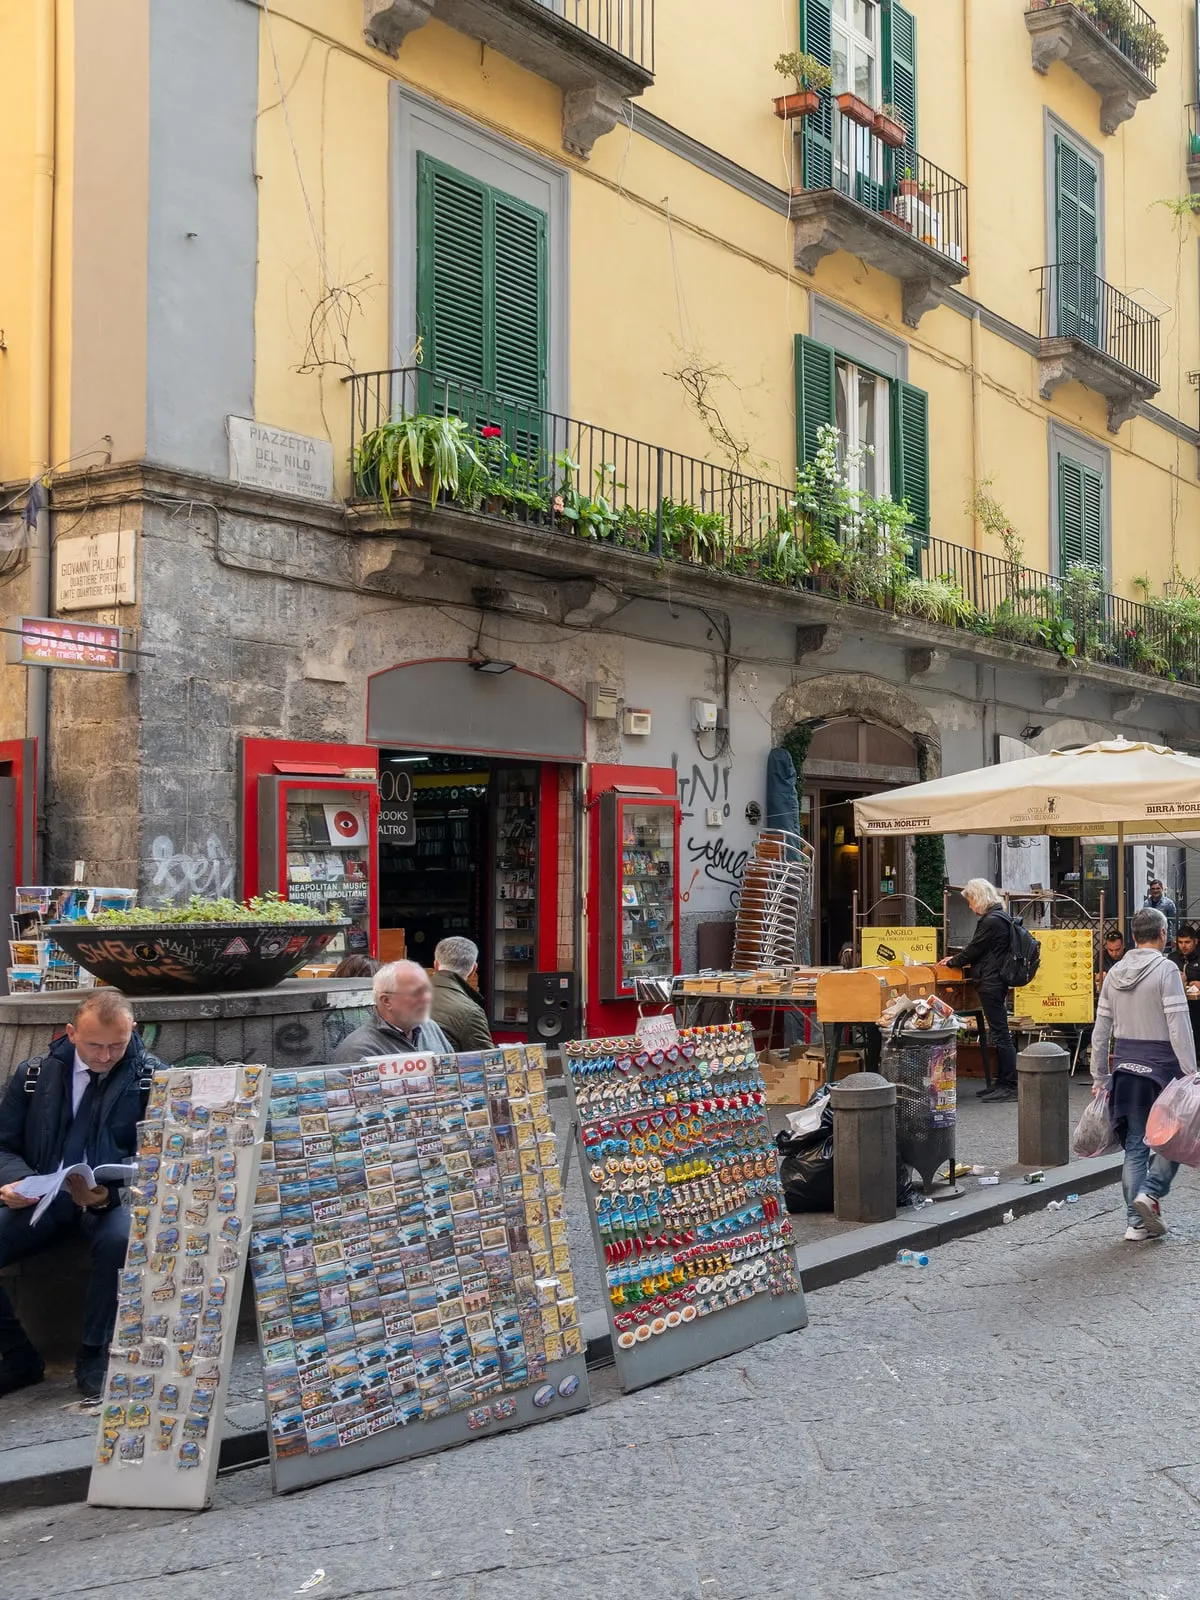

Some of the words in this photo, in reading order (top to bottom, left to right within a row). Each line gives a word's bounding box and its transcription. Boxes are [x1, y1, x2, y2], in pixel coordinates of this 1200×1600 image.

[249, 427, 316, 455] PIAZZETTA
[256, 447, 278, 463] DEL
[284, 454, 310, 471] NILO
[88, 545, 98, 558] VIA
[61, 559, 90, 577] GIOVANNI
[70, 574, 98, 593] QUARTIERE
[100, 572, 117, 584] PORTO
[60, 588, 75, 600] LIMITE
[77, 585, 103, 600] QUARTIERE
[1146, 805, 1174, 813] BIRRA
[867, 820, 892, 828] BIRRA
[894, 818, 930, 828] MORETTI
[289, 883, 338, 892] NEAPOLITAN
[342, 882, 367, 891] MUSIC
[289, 892, 322, 900] MUSIQUE
[323, 889, 367, 899] NAPOLITAINE
[885, 929, 913, 937] ANGELO
[925, 943, 933, 952] €
[378, 1063, 388, 1075] €
[391, 1058, 428, 1075] 1,00
